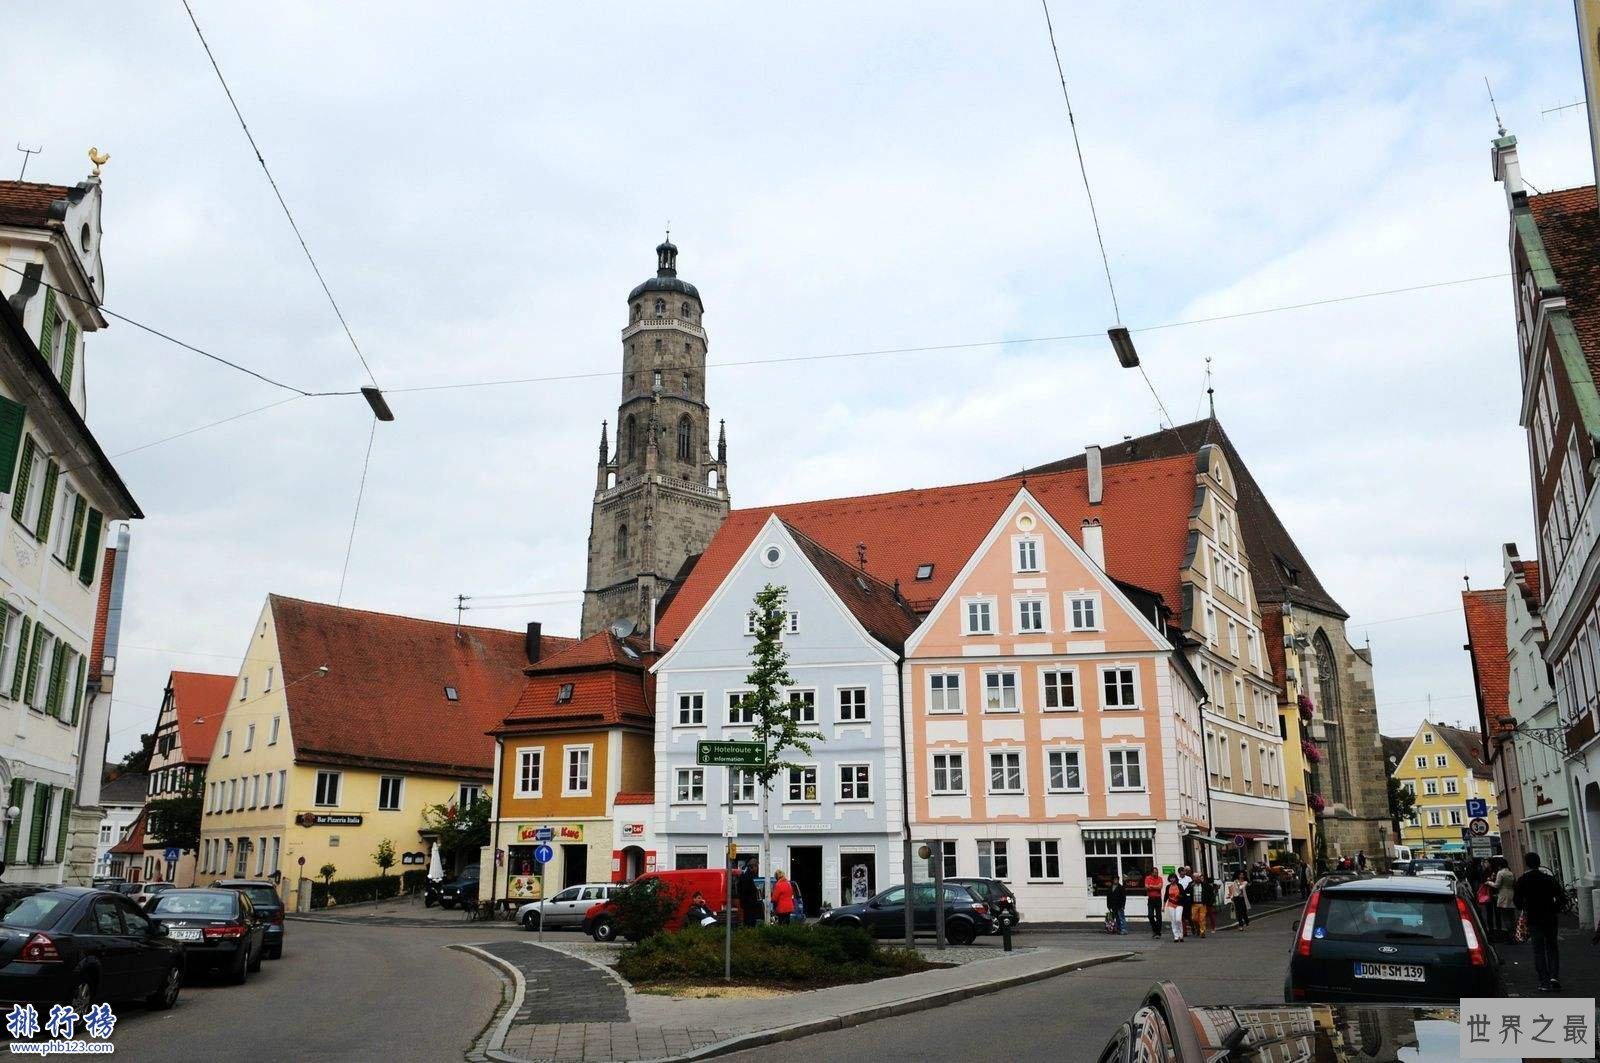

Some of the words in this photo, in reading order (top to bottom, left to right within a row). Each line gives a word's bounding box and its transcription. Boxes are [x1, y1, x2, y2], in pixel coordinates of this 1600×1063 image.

[1361, 963, 1382, 976] DON
[1388, 965, 1402, 977] SM
[1404, 966, 1423, 978] 139
